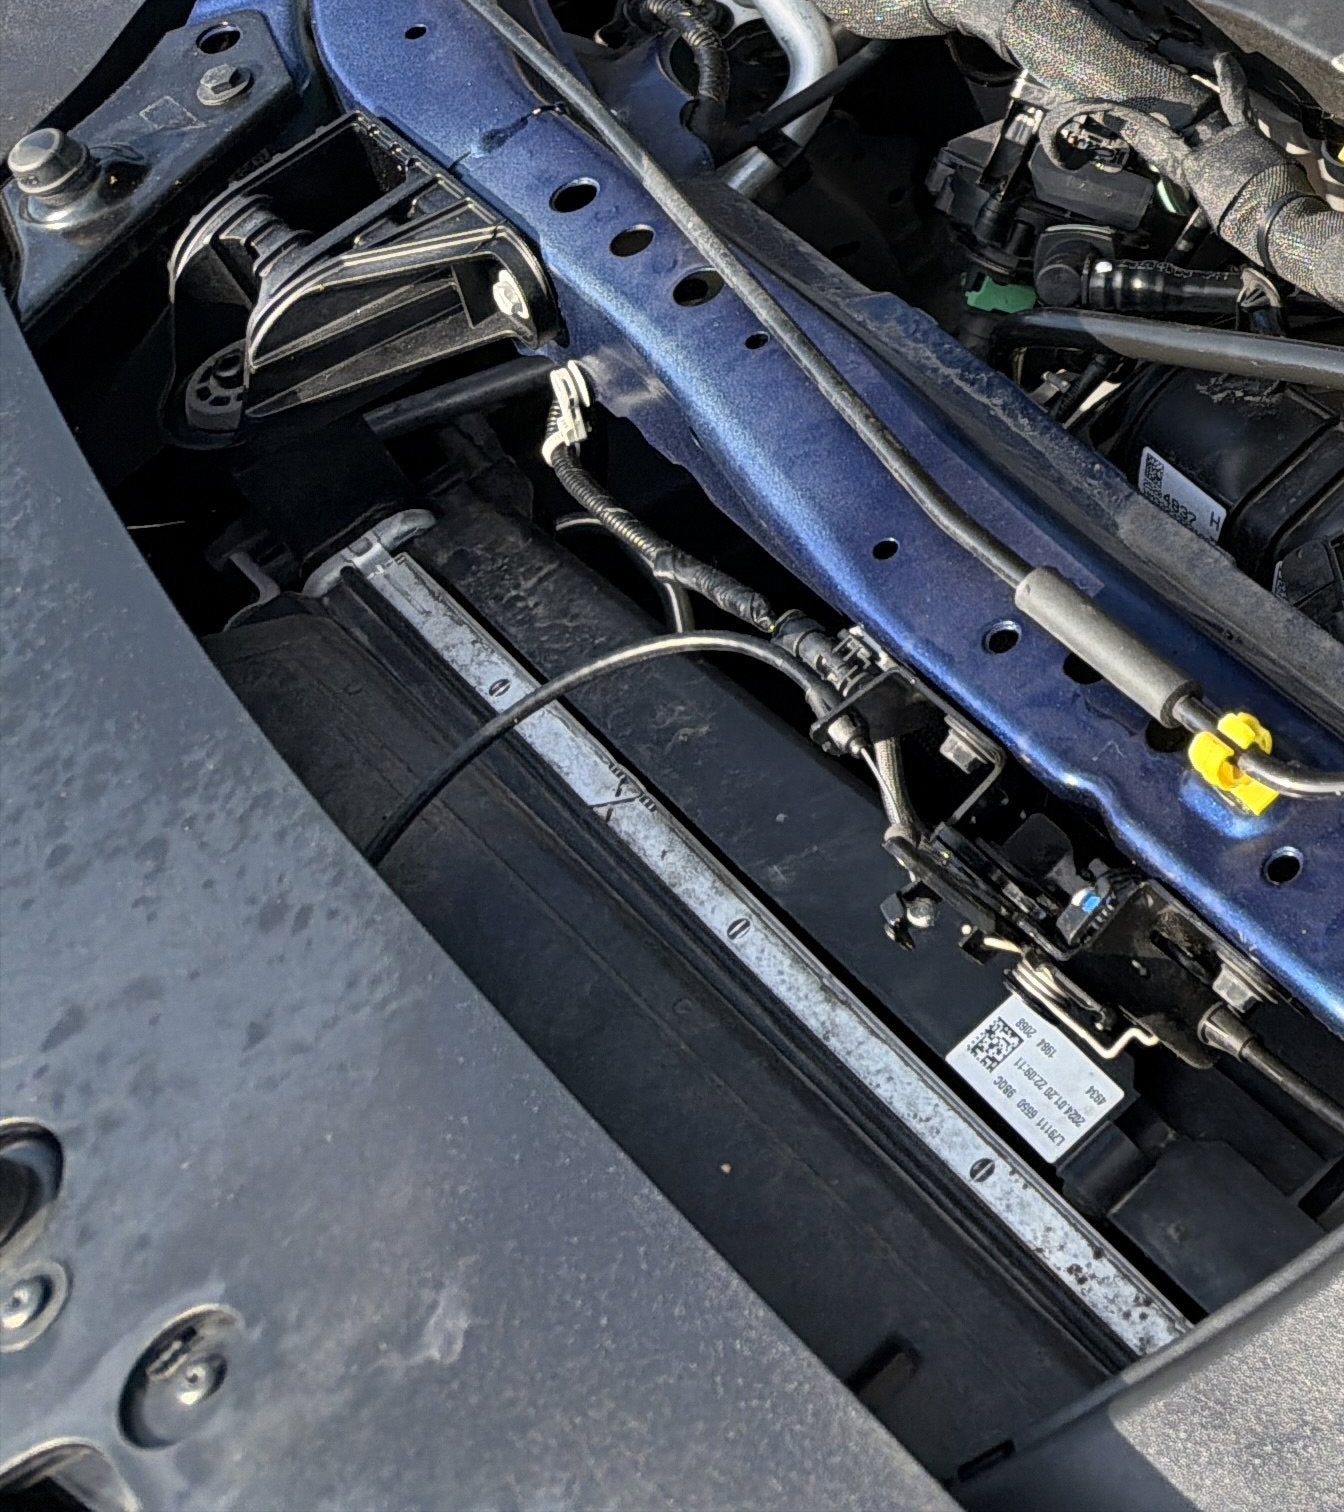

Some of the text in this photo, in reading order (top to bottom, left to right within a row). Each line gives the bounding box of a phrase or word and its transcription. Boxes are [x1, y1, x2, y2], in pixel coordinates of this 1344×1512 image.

[1210, 511, 1221, 532] H
[1013, 1057, 1086, 1128] 2024.01.20 22:09:11
[1015, 1017, 1107, 1106] 4934 1984 2068
